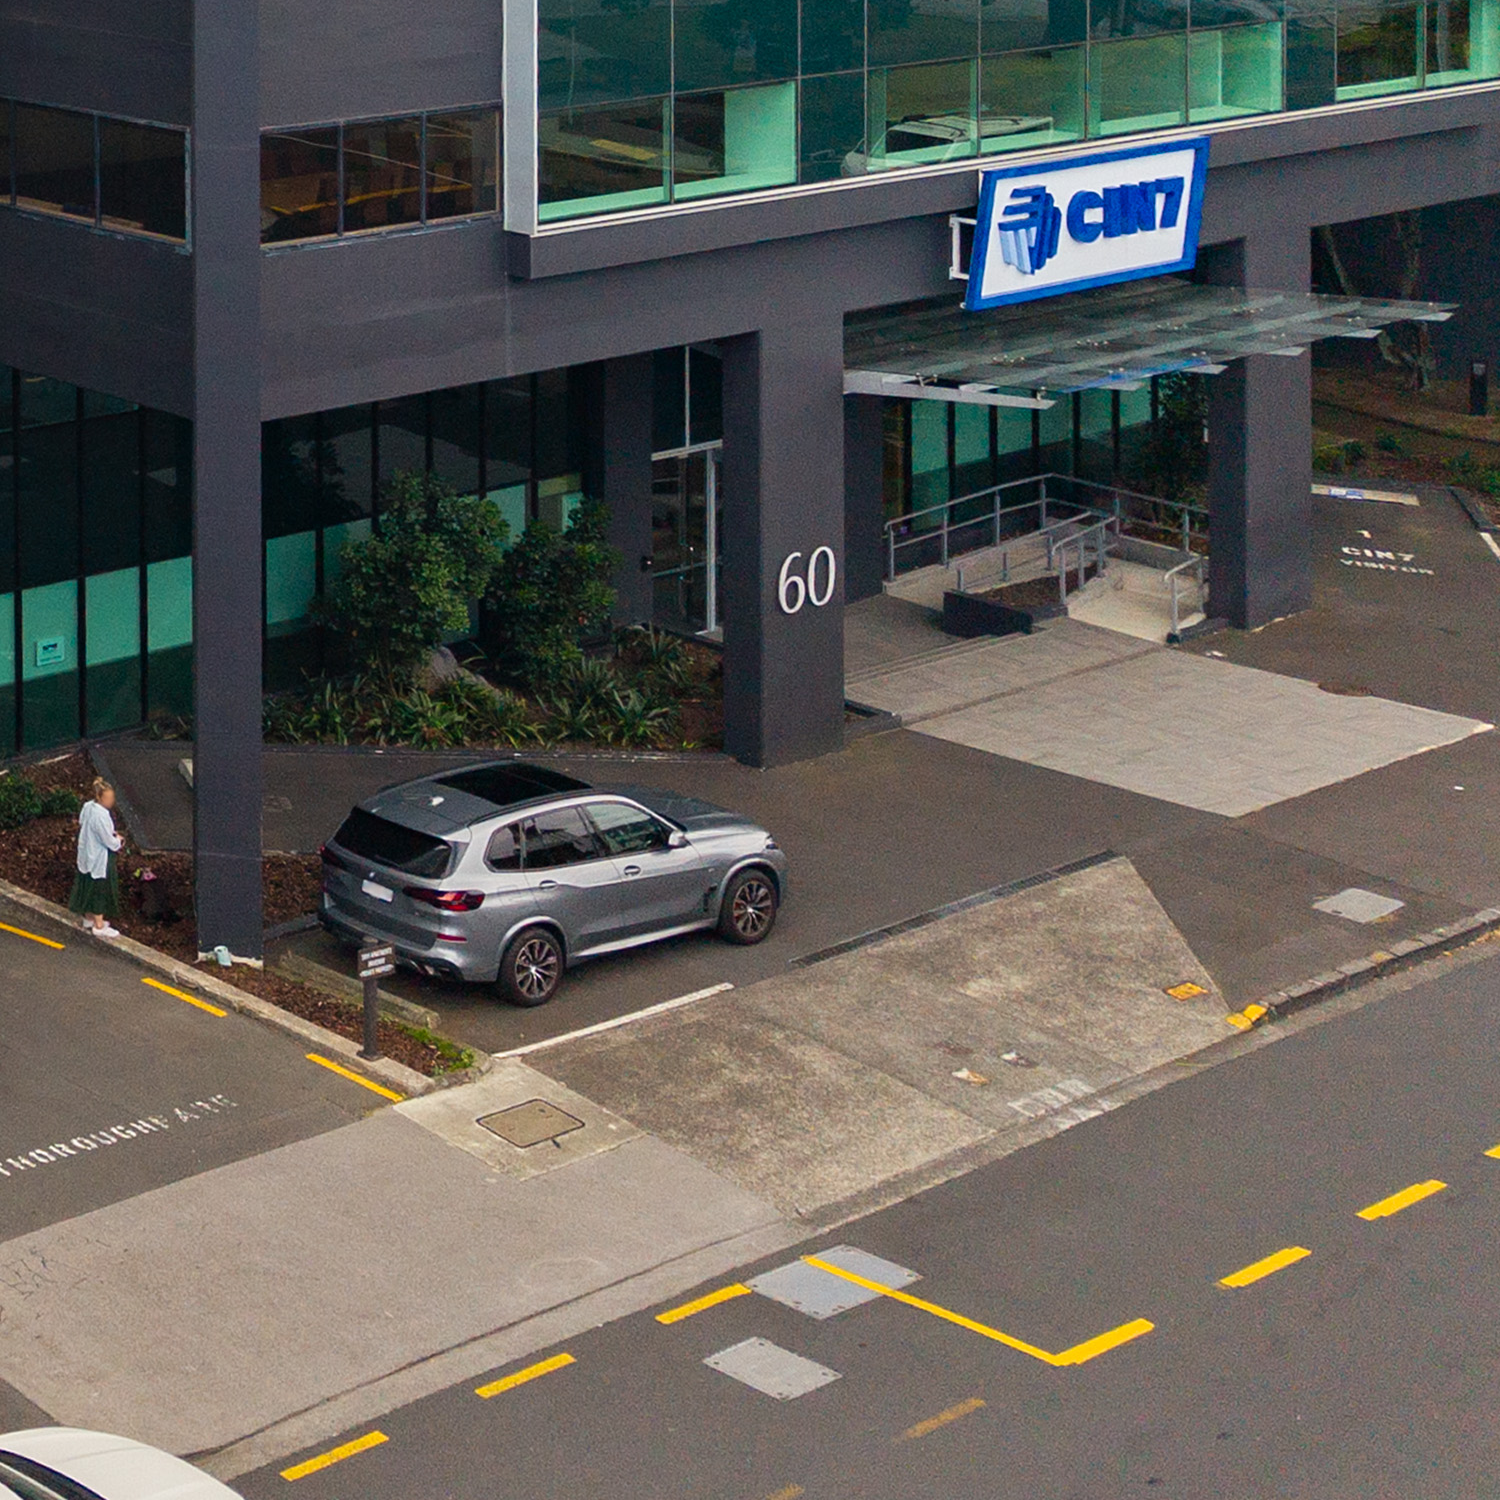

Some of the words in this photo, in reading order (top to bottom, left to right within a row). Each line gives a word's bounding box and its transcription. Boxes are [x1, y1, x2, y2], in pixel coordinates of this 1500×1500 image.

[1066, 176, 1185, 243] CIN7
[1339, 558, 1435, 576] VISITOR
[1341, 546, 1415, 562] CIN7
[778, 546, 836, 614] 60
